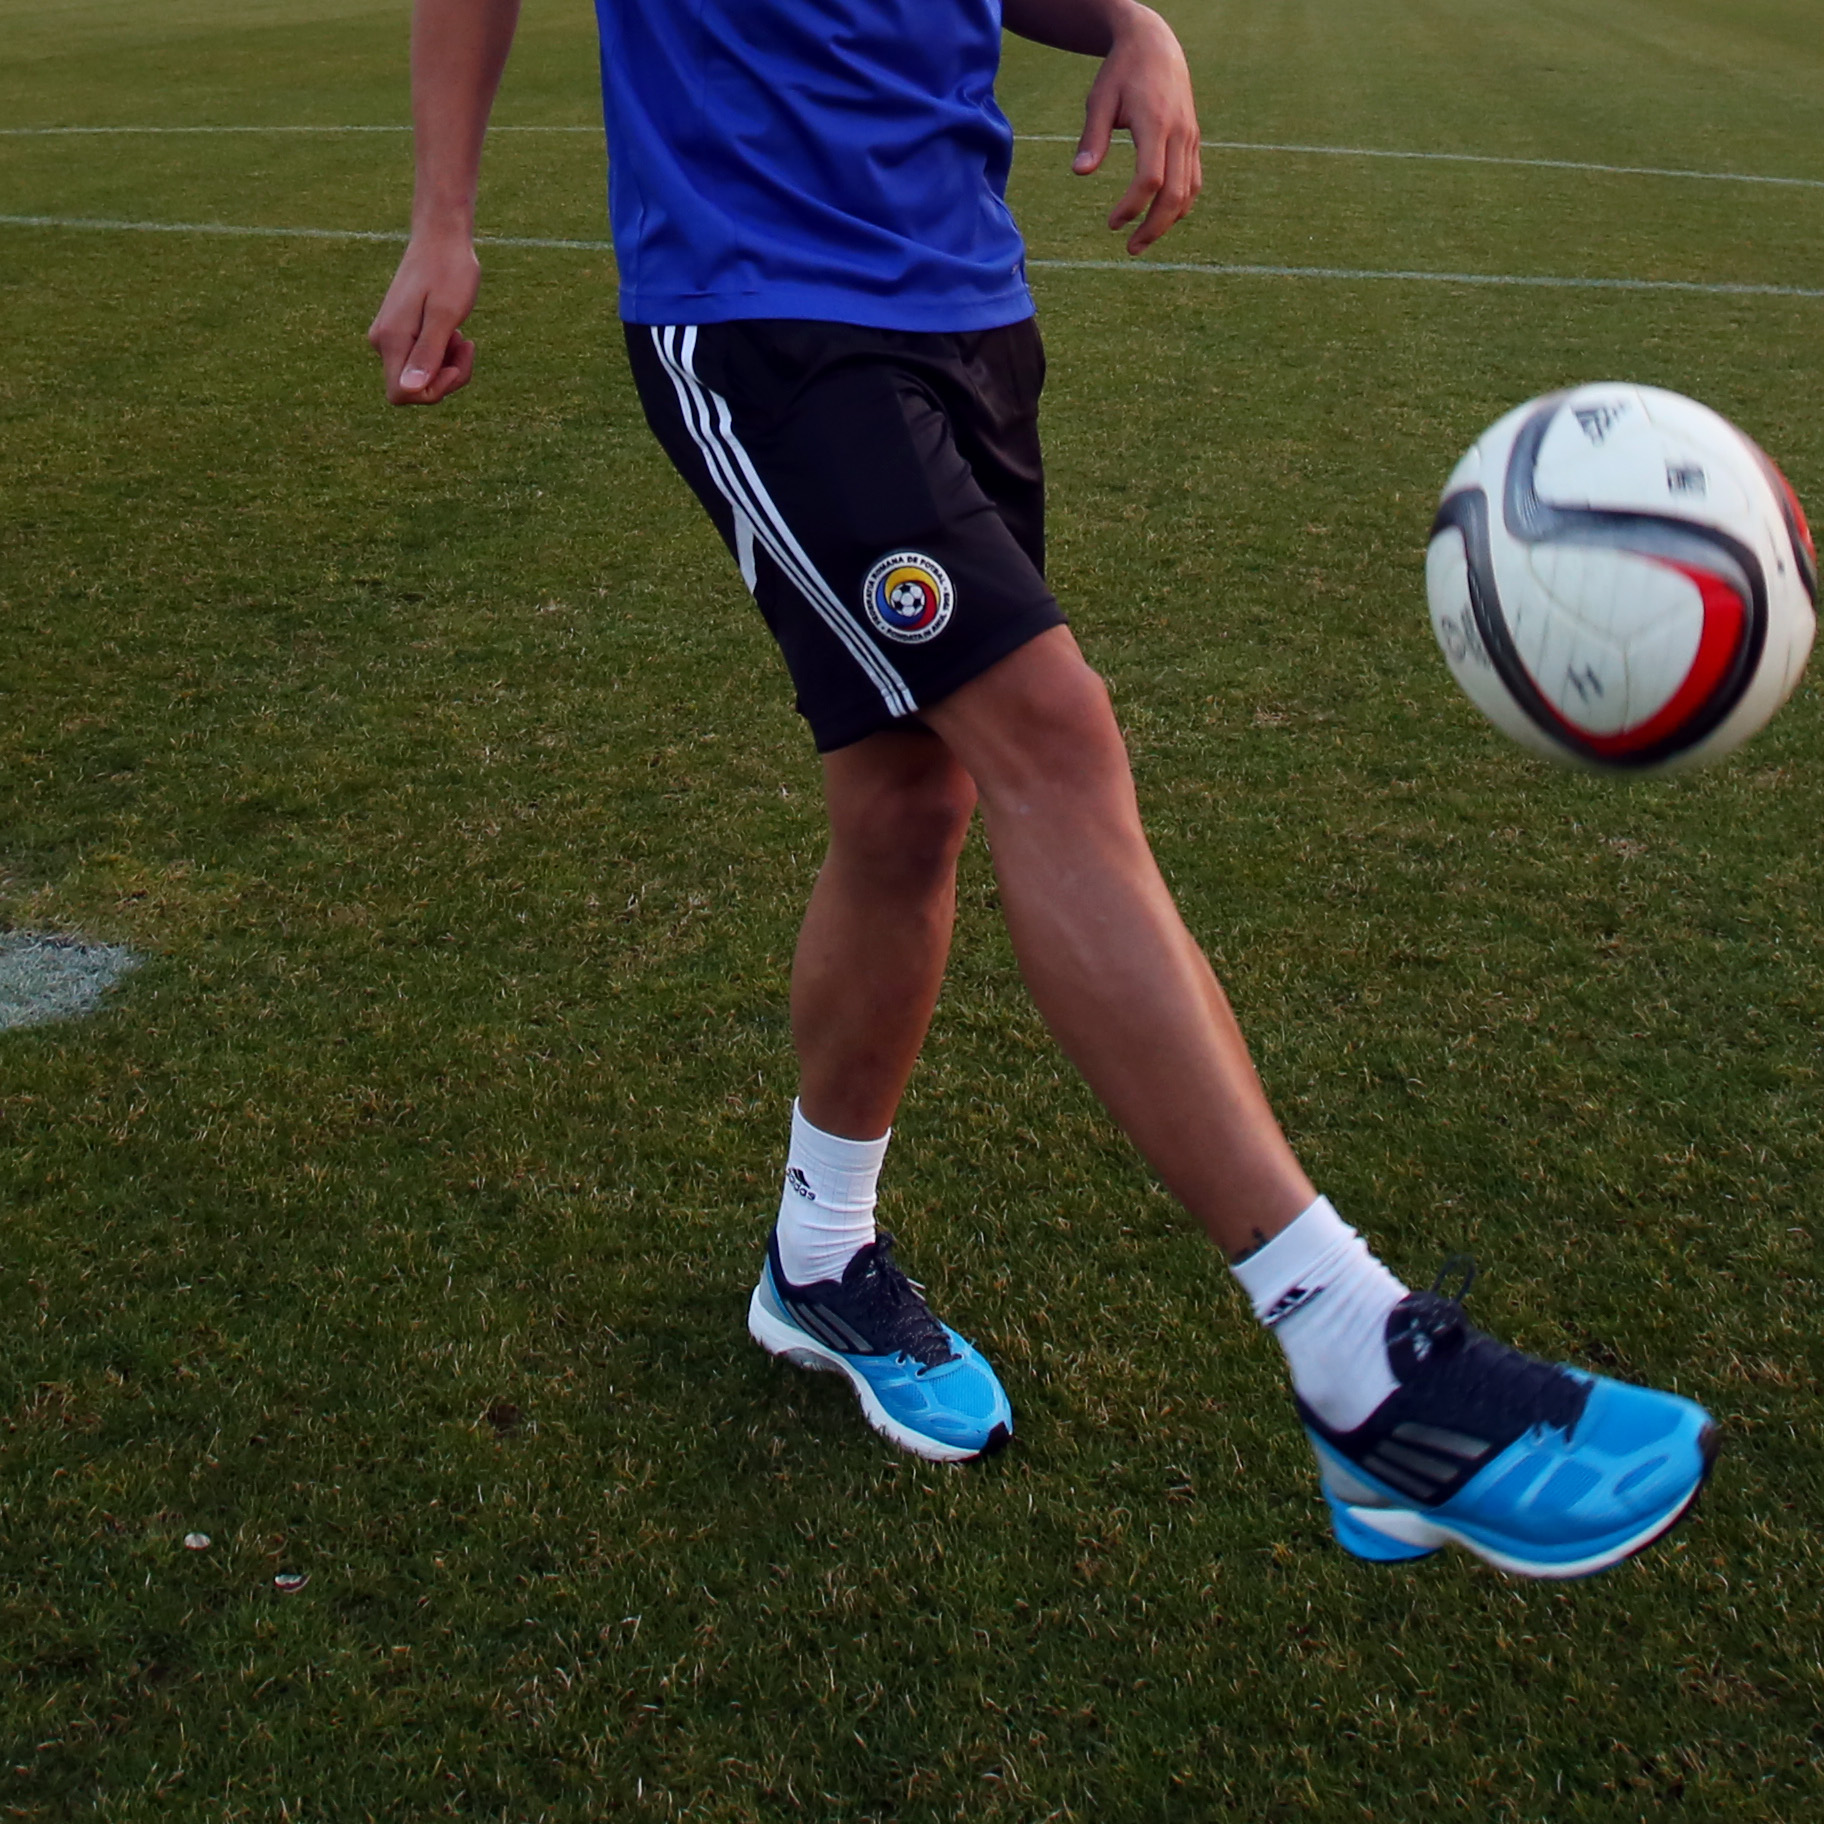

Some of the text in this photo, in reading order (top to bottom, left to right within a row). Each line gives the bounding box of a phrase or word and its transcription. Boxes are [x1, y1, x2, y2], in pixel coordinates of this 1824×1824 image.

[872, 556, 904, 579] ROMANA
[906, 556, 918, 564] DE
[919, 558, 946, 585] FOTBAL
[786, 1167, 817, 1201] ddas
